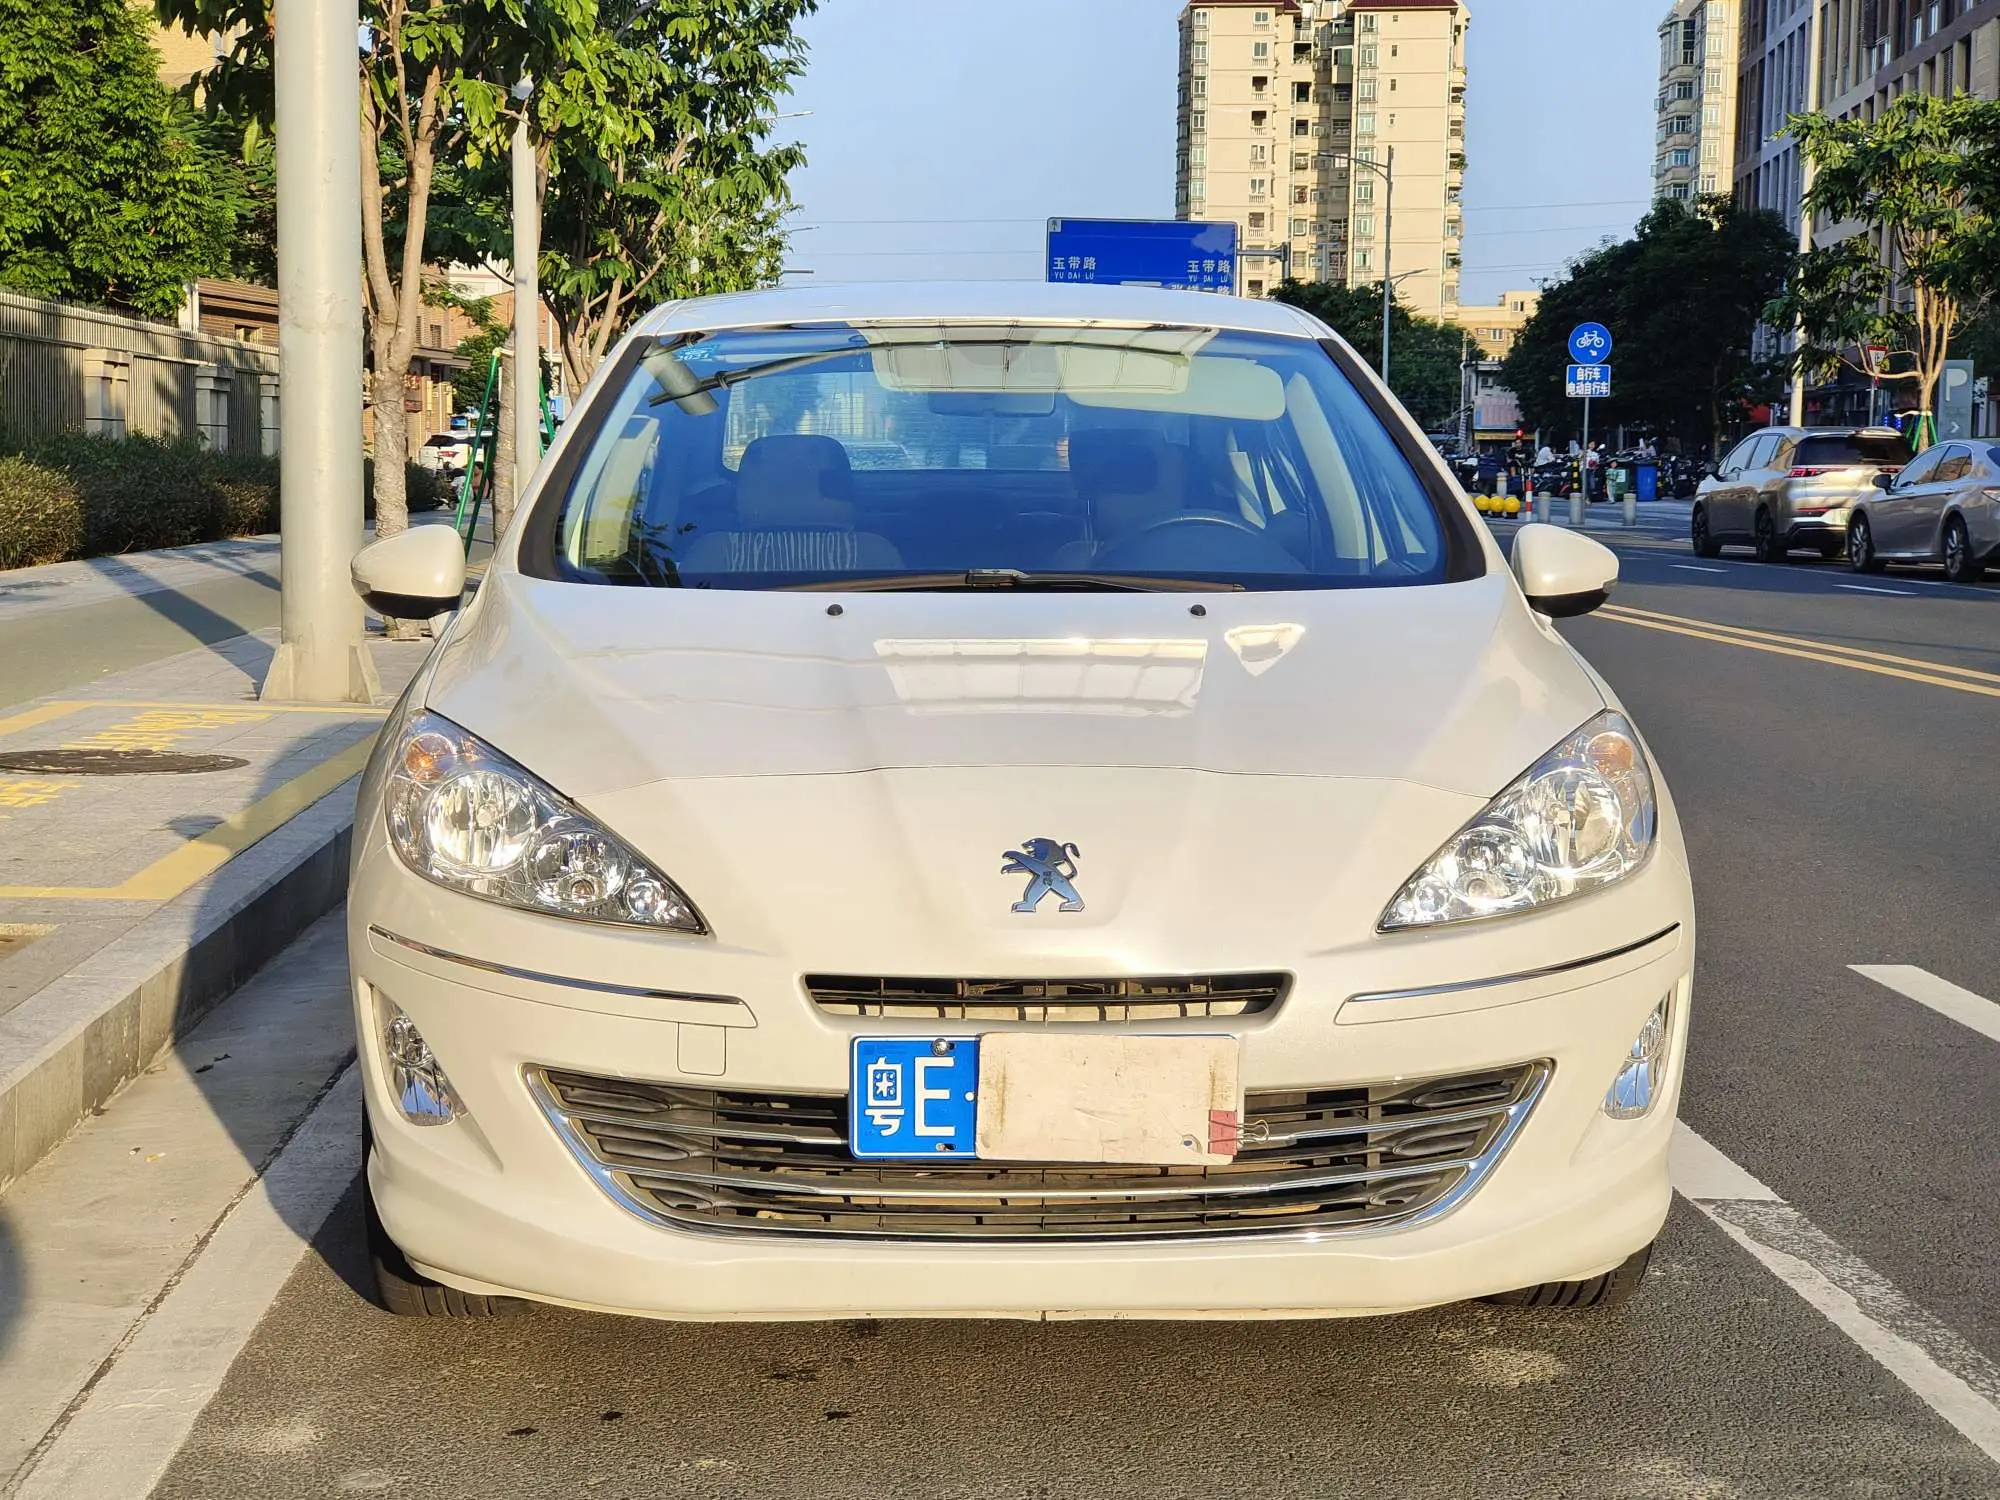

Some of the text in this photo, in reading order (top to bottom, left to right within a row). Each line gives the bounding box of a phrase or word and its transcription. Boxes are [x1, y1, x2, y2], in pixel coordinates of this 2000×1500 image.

[1052, 256, 1096, 270] 玉带路
[1187, 259, 1231, 273] 玉带路
[1055, 271, 1095, 280] YU DAI LU
[1188, 274, 1198, 282] YU
[1577, 367, 1601, 381] 自行车
[1567, 381, 1608, 395] 电动自行车
[1945, 368, 1968, 402] P
